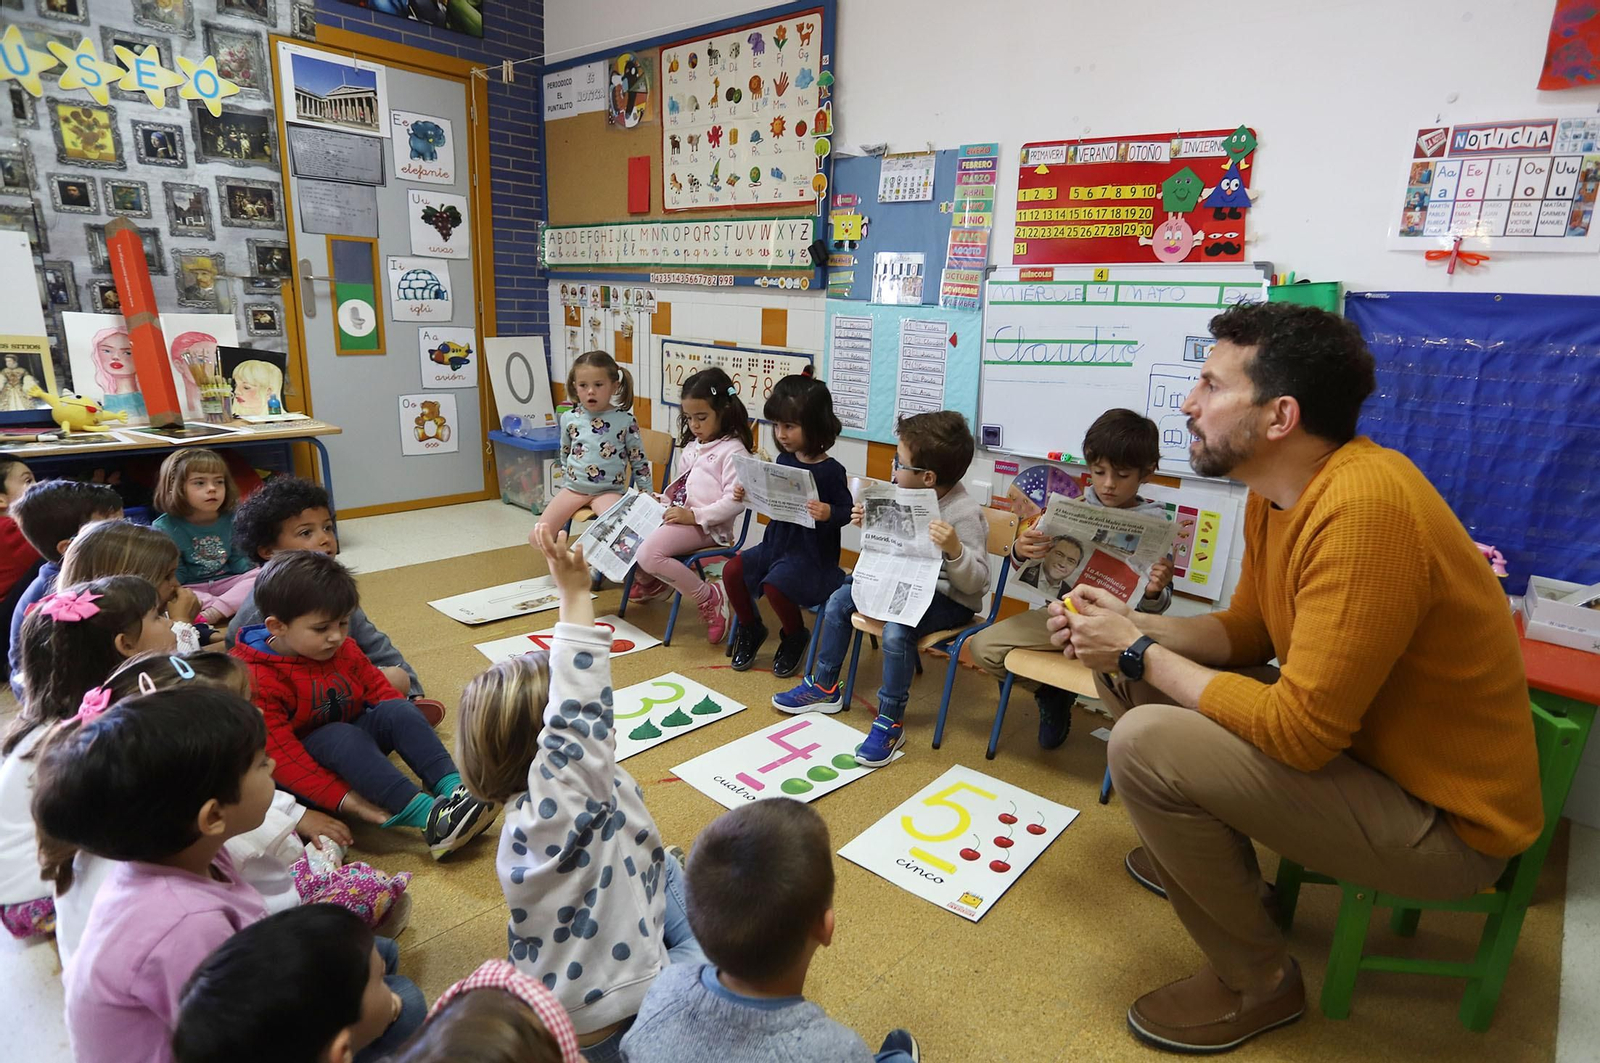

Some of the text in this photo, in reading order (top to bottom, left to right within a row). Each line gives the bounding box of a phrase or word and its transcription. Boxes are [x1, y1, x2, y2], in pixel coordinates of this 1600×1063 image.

[1454, 129, 1550, 149] NOTICIA
[1030, 149, 1064, 160] PRIMAVERA
[1078, 145, 1115, 162] VERANO
[1129, 143, 1162, 161] OTOÑO
[962, 160, 993, 169] FEBRERO
[1437, 165, 1457, 178] Aa
[1466, 164, 1483, 177] Ee
[1524, 162, 1545, 175] Oo
[1555, 161, 1578, 175] Uu
[962, 174, 990, 183] MARZO
[963, 188, 985, 197] ABRIL
[1022, 186, 1155, 200] 1 2 3 5 6 7 8 9 10
[1438, 185, 1566, 199] a e i o u
[1018, 208, 1152, 220] 11 12 13 14 15 16 17 18 19 20
[1016, 224, 1152, 238] 21 22 23 24 25 26 27 28 29 30
[428, 245, 454, 254] uvas
[1016, 244, 1025, 254] 31
[945, 272, 979, 282] OCTUBRE
[1097, 270, 1104, 280] 4
[1097, 286, 1108, 300] 4
[1125, 285, 1186, 302] MAYO
[993, 325, 1145, 364] Claudio
[435, 373, 466, 382] avión
[665, 364, 672, 385] 1
[732, 373, 741, 395] 6
[748, 374, 758, 398] 7
[763, 377, 773, 400] 8
[1084, 572, 1119, 594] que quieres
[1087, 566, 1126, 591] La Andalucía
[757, 720, 822, 775] 4
[713, 775, 756, 802] cuatro
[900, 780, 998, 842] 5
[895, 856, 945, 885] cinco
